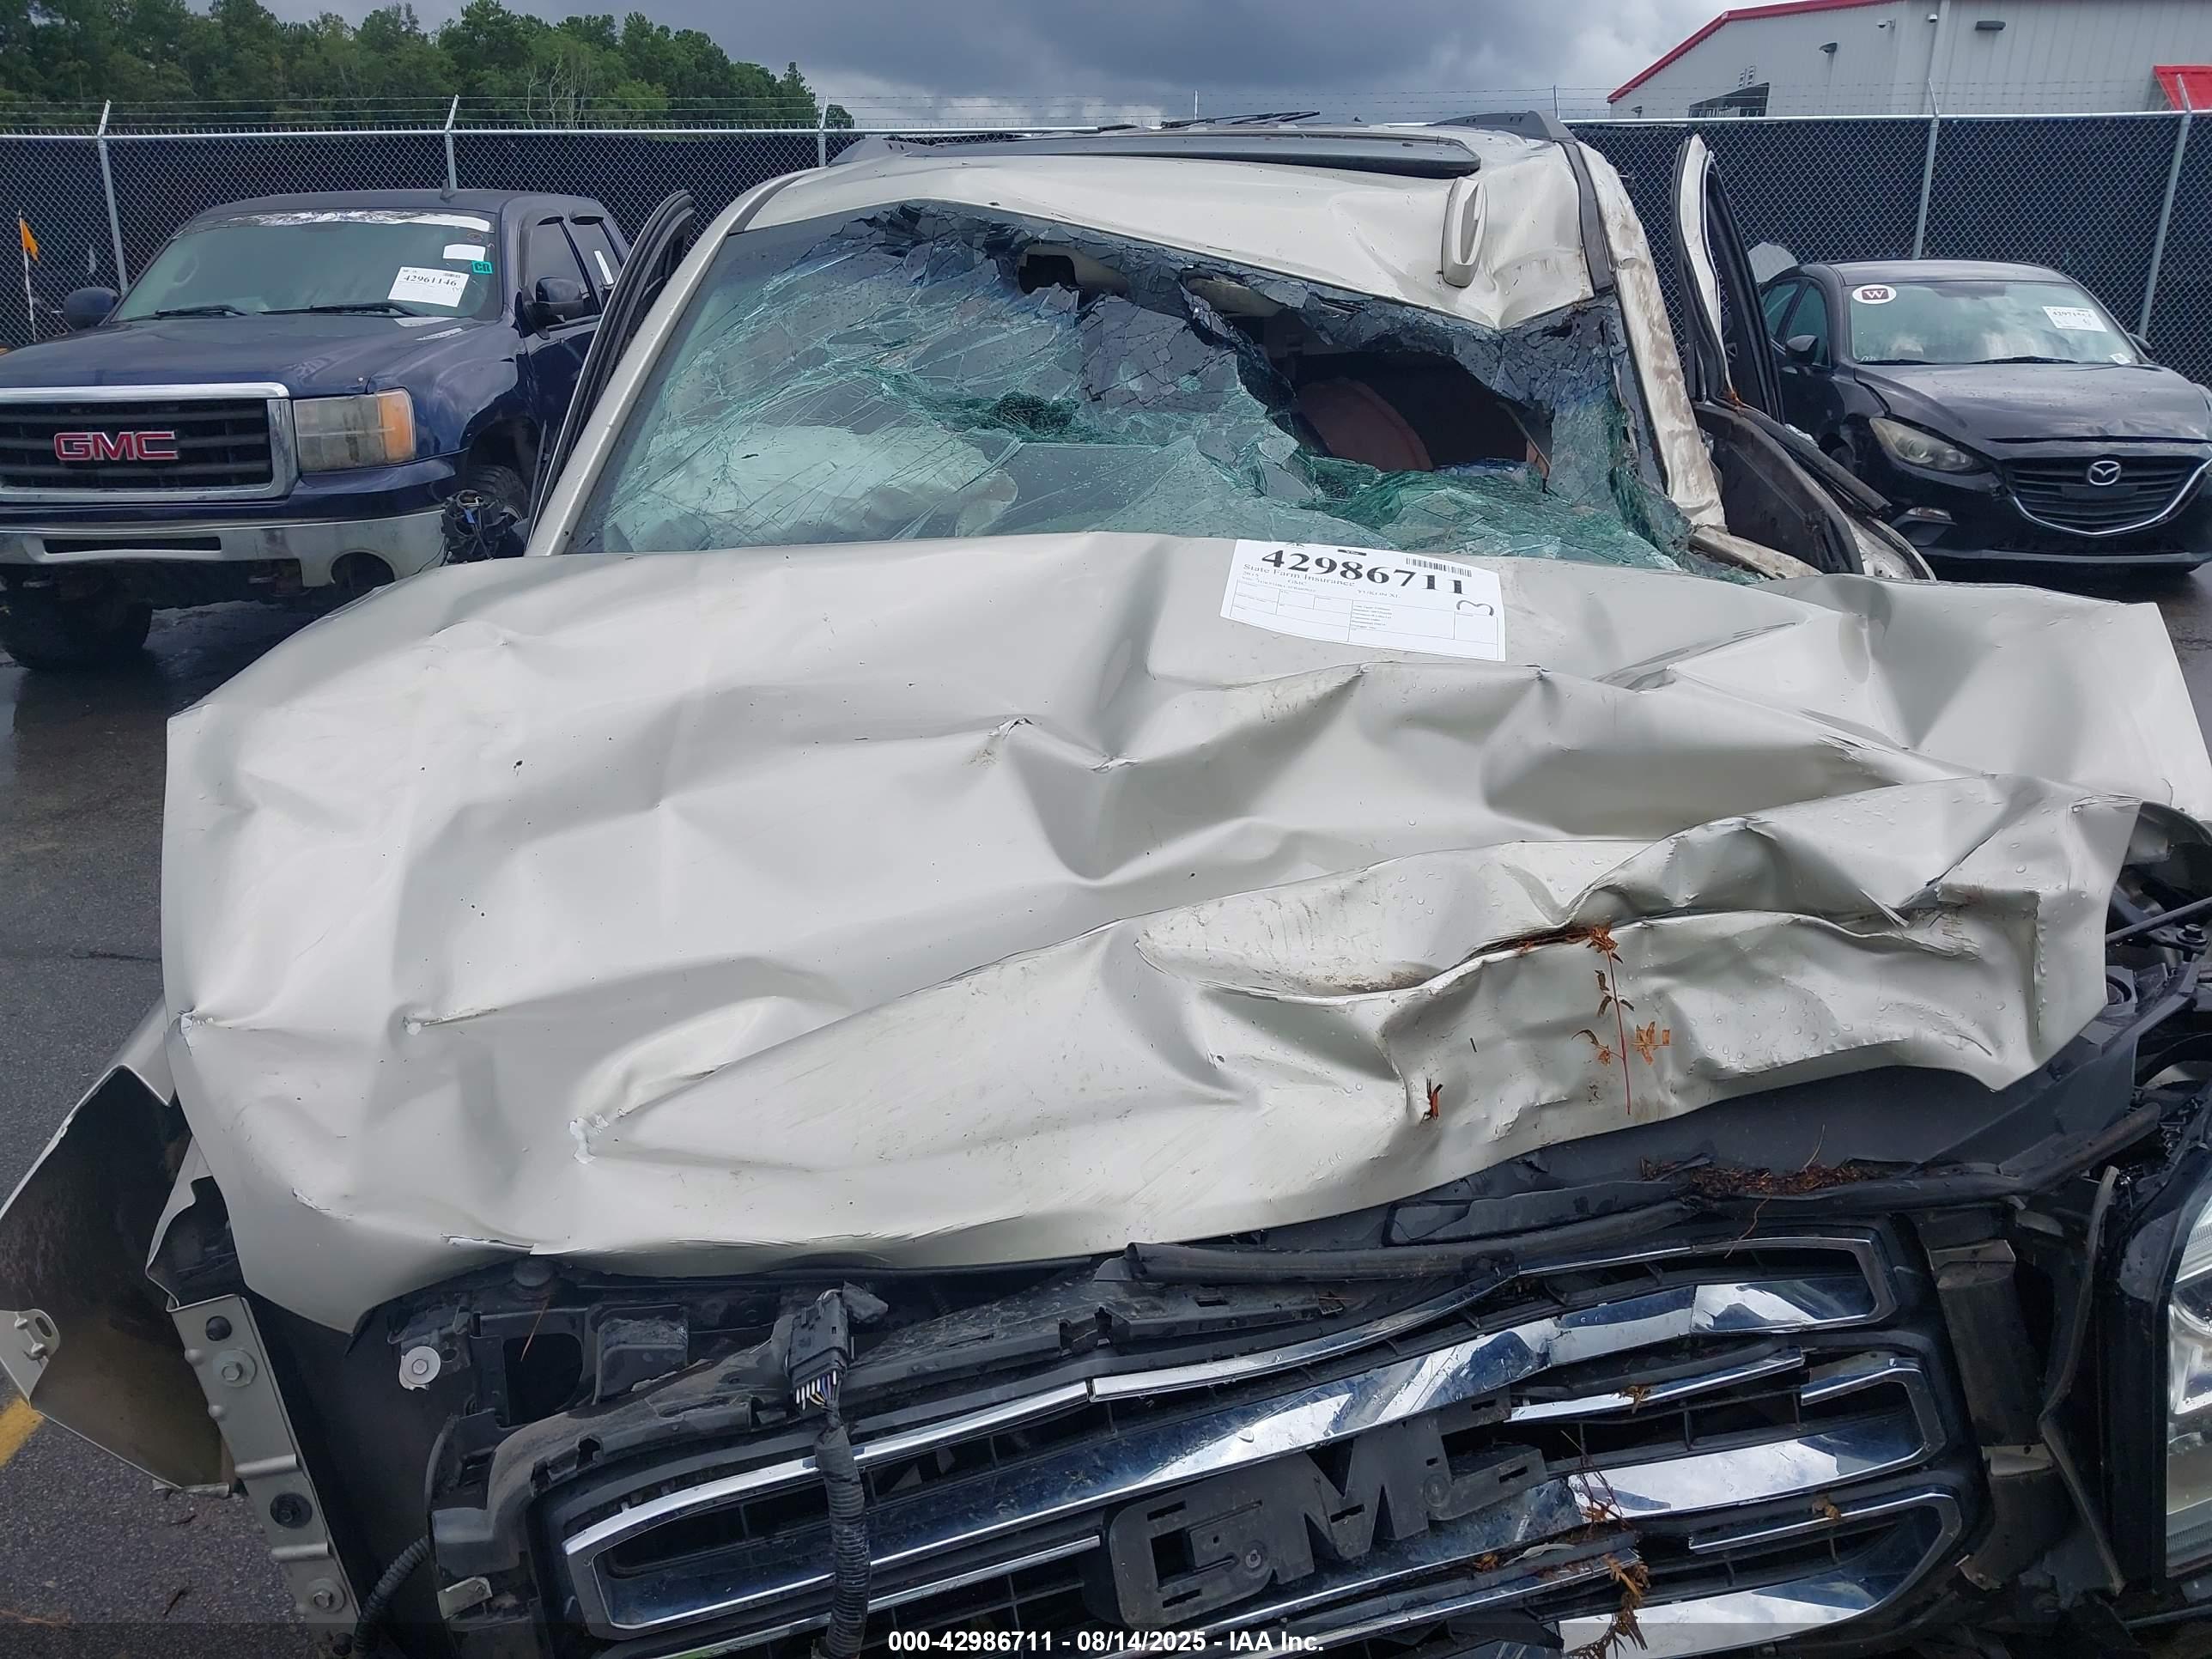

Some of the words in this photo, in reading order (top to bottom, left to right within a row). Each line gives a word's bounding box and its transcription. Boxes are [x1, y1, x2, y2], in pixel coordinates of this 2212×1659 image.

[474, 261, 491, 273] CR
[404, 275, 457, 287] 42961146
[53, 431, 179, 460] GMC
[1243, 563, 1271, 574] State
[1273, 568, 1300, 580] Farm
[1304, 574, 1355, 587] Insurance
[1261, 550, 1469, 595] 42986711
